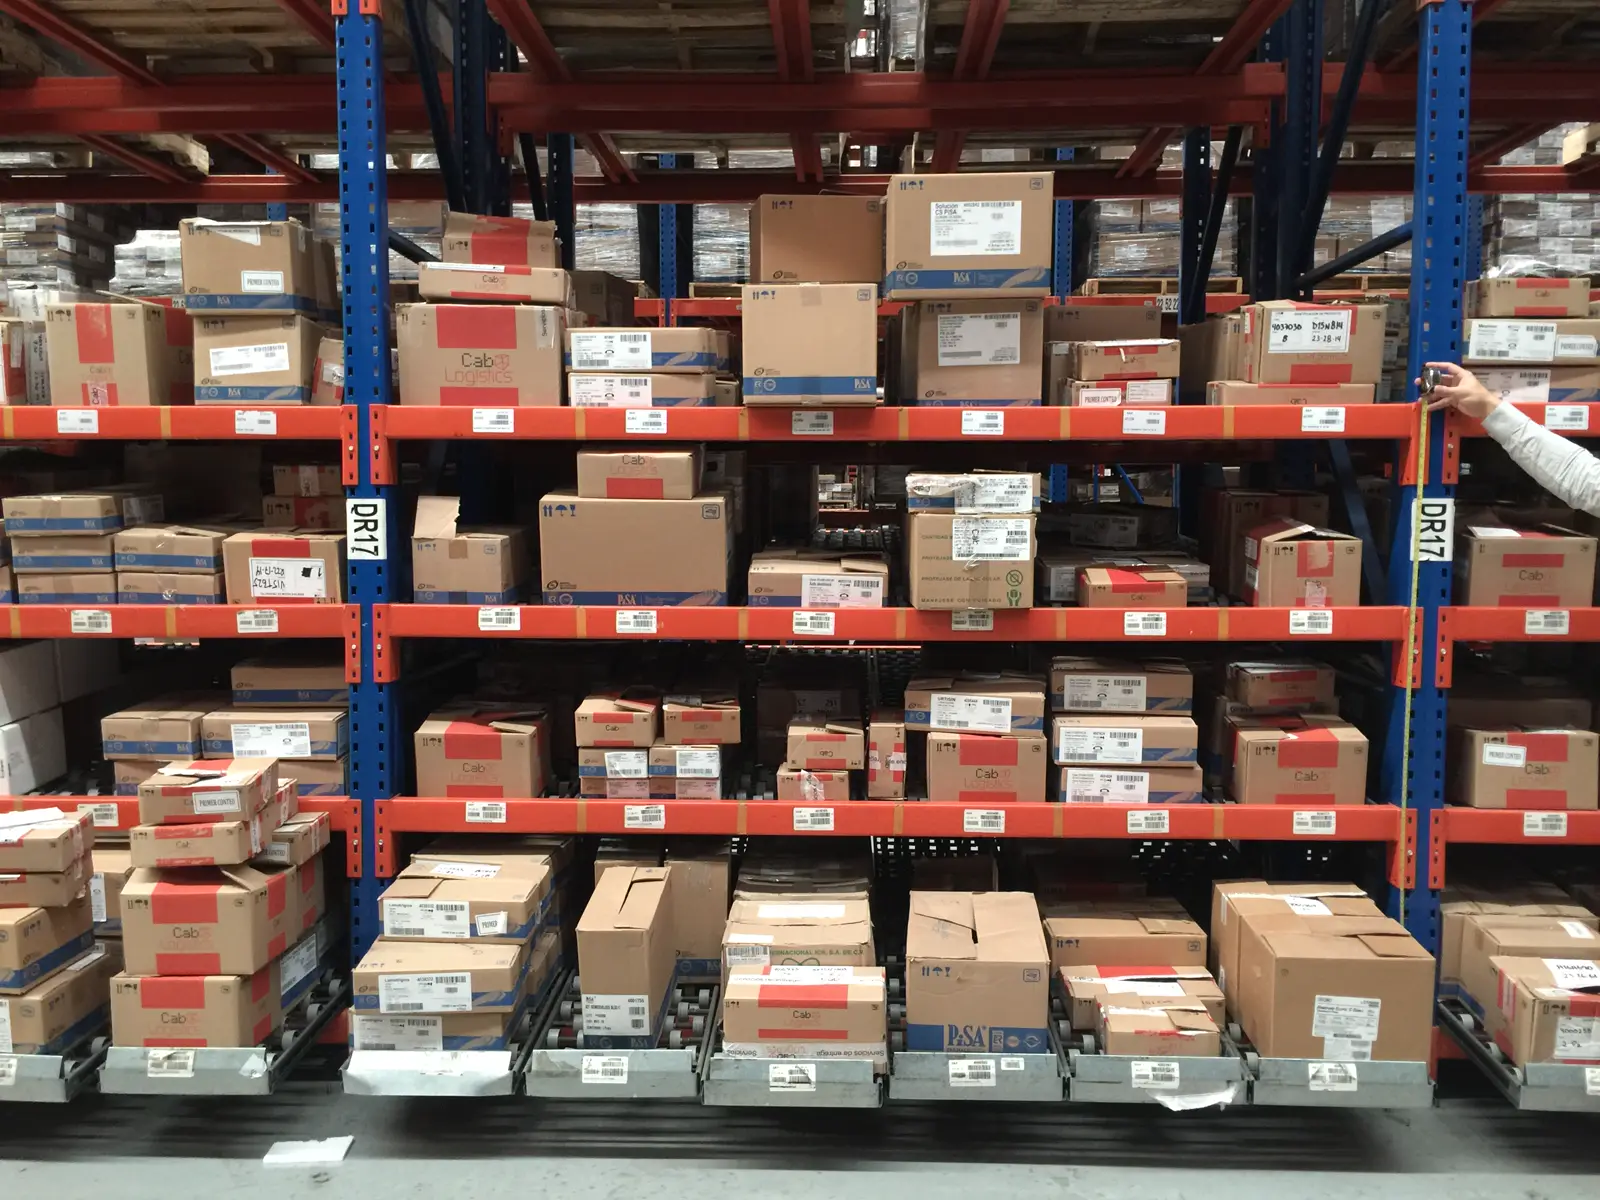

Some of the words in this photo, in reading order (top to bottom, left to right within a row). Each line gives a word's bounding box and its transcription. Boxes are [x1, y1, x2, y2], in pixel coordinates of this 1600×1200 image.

[482, 274, 499, 283] Cab
[461, 352, 494, 368] Cab
[445, 366, 513, 386] Logistics
[622, 455, 646, 466] Cab
[351, 503, 379, 557] DR17
[1419, 503, 1447, 558] DR17
[1519, 569, 1544, 581] Cab
[605, 724, 620, 732] Cab
[462, 762, 486, 773] Cab
[1524, 763, 1550, 775] Cab
[975, 768, 999, 779] Cab
[1294, 771, 1319, 781] Cab
[200, 796, 217, 807] PRIMER
[173, 927, 199, 938] Cab
[161, 1012, 187, 1024] Cab
[793, 1010, 812, 1019] Cab
[947, 1024, 987, 1047] PiSA
[816, 1049, 840, 1057] entrega
[853, 1049, 885, 1057] Servicios
